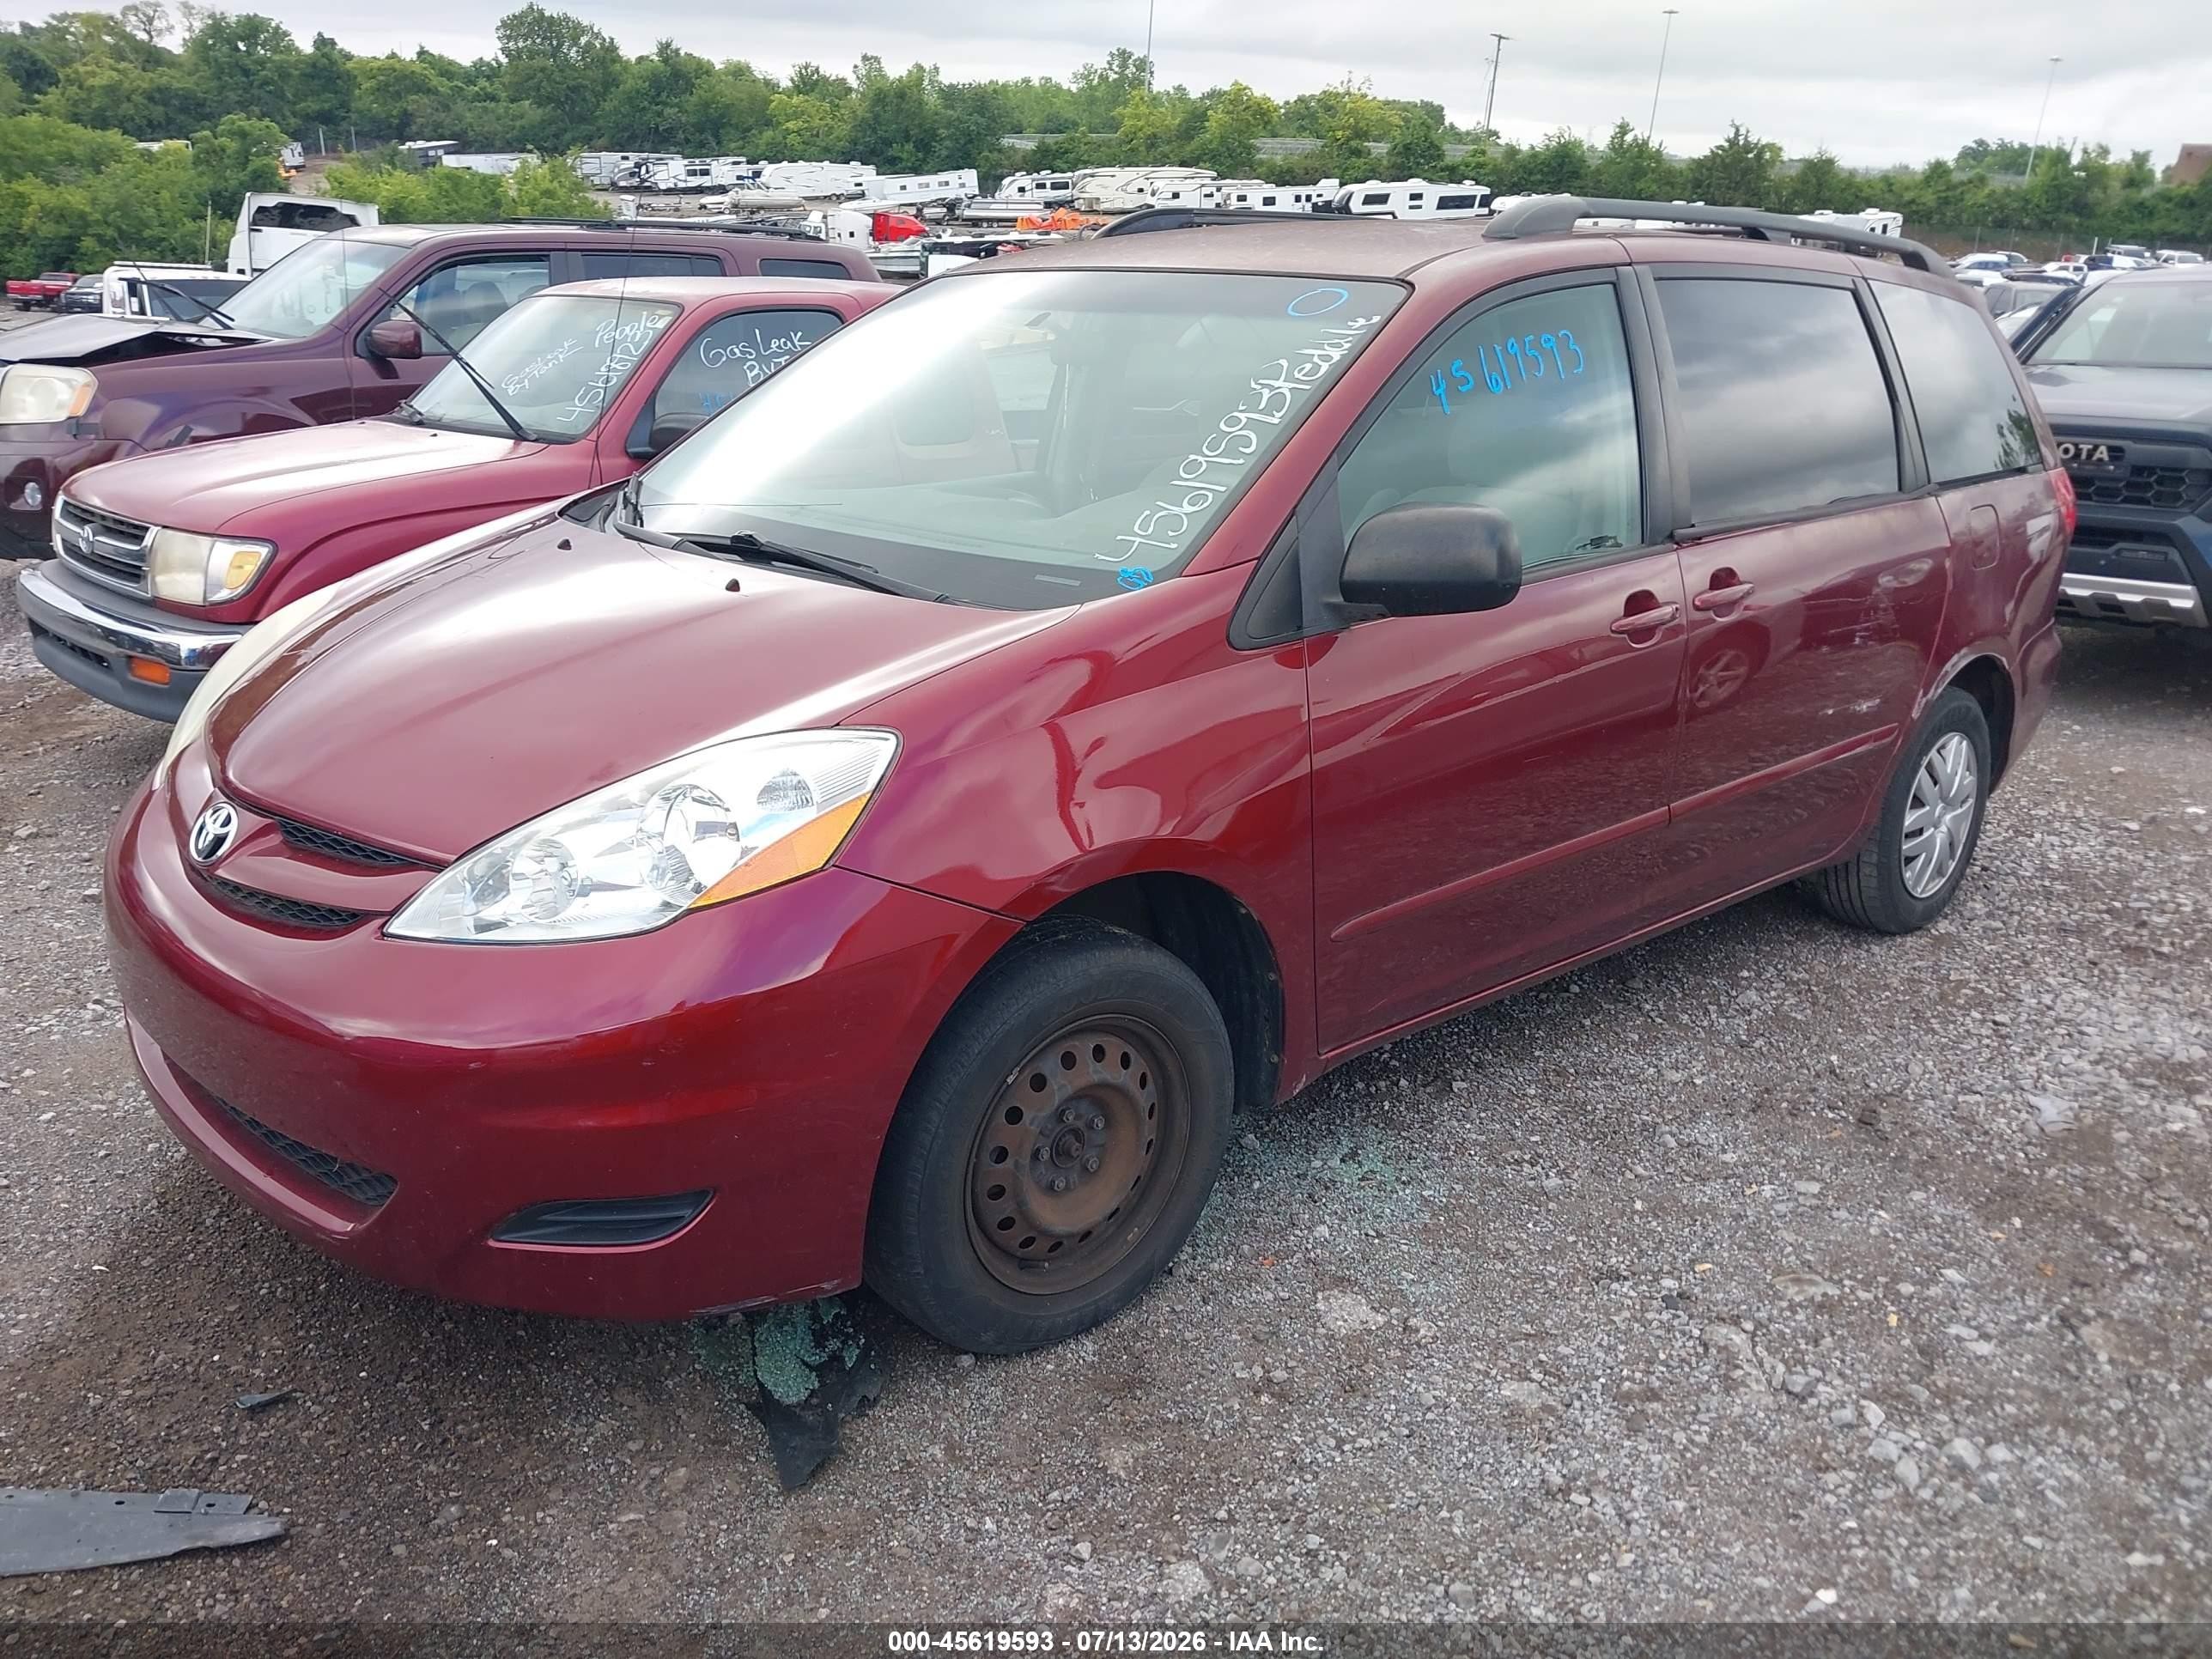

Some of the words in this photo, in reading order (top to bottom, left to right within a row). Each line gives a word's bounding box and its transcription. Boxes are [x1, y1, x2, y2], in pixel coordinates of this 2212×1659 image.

[700, 337, 756, 368] Gas
[755, 328, 812, 355] Leak
[1093, 378, 1291, 562] 45619593
